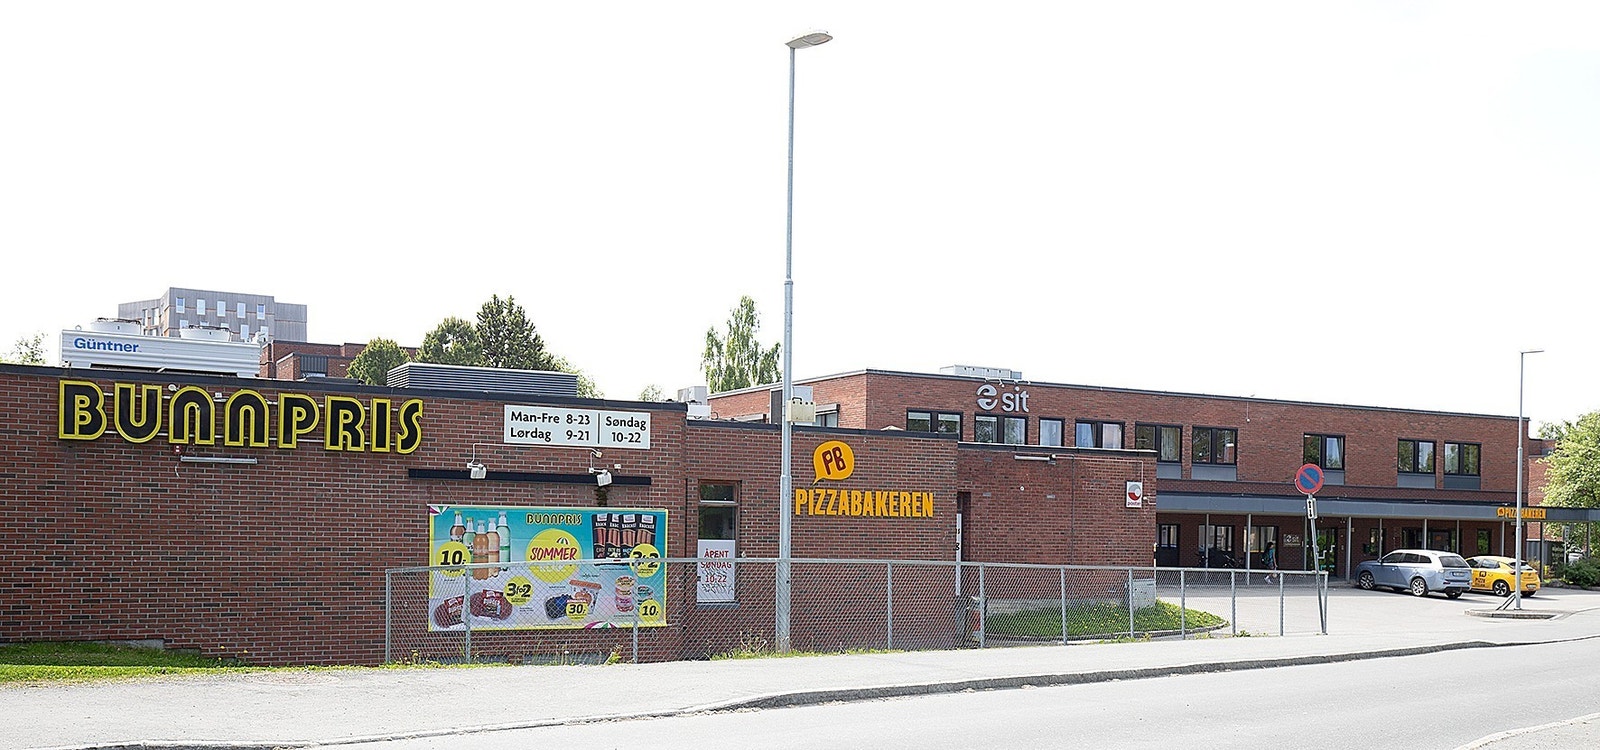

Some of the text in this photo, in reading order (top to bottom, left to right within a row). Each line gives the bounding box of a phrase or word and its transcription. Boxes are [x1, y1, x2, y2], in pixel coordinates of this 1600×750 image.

[74, 337, 140, 353] Güntner
[1001, 387, 1029, 412] sit
[59, 379, 424, 454] BUNNPRIS
[510, 411, 591, 425] Man-Fre 8-23
[605, 416, 647, 431] Søndag
[510, 427, 590, 442] Lørdag 9-21
[611, 432, 642, 443] 10-22
[821, 446, 847, 475] PB
[794, 488, 934, 518] PIZZABAKEREN
[526, 513, 583, 526] BUNNPRIS
[530, 547, 578, 561] SOMMER
[704, 547, 730, 558] ÅPENT
